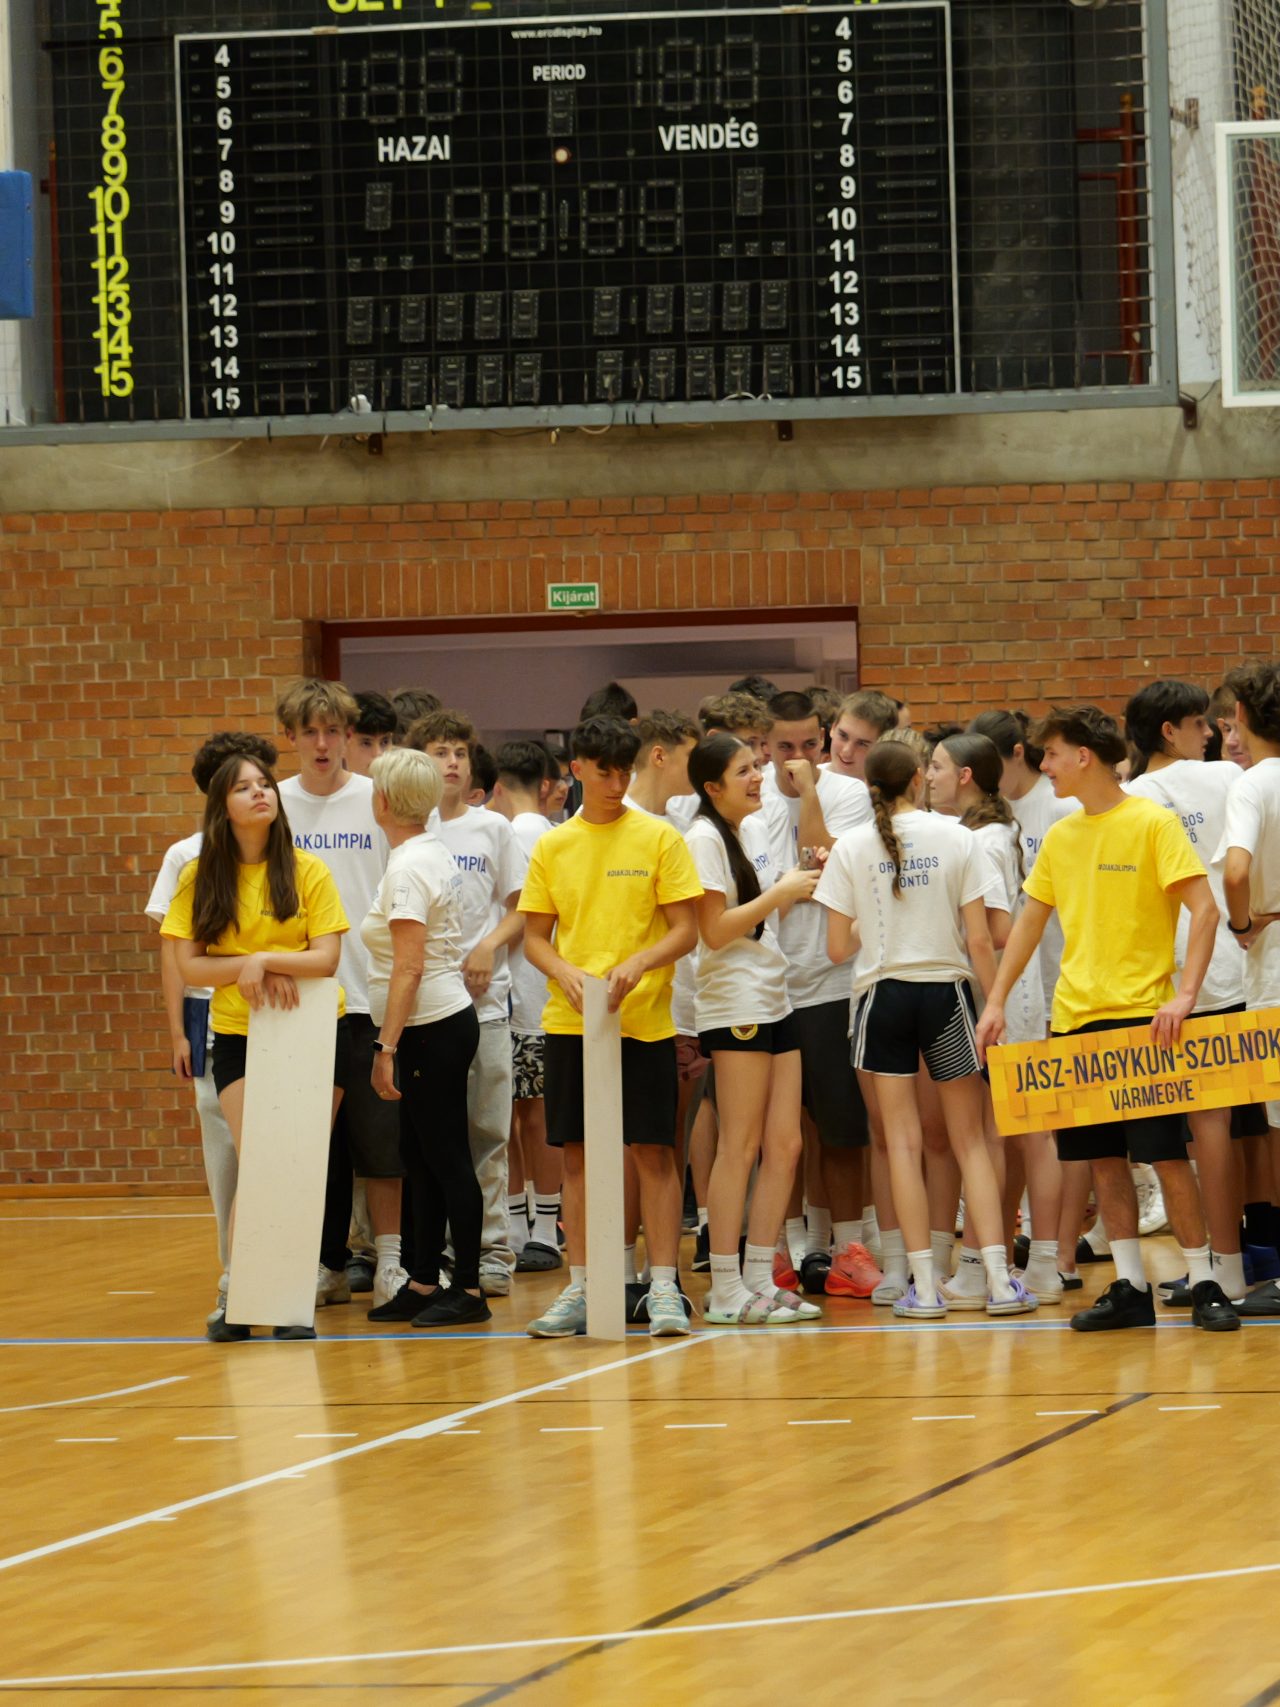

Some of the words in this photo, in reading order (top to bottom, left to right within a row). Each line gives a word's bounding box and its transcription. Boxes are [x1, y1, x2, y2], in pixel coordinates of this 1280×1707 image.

[98, 10, 123, 39] 5
[835, 16, 851, 40] 4
[98, 47, 125, 82] 6
[214, 44, 230, 67] 4
[837, 49, 853, 72] 5
[532, 64, 586, 82] PERIOD
[102, 80, 125, 116] 7
[216, 76, 232, 99] 5
[837, 80, 854, 104] 6
[217, 107, 233, 130] 6
[838, 112, 854, 135] 7
[101, 115, 127, 150] 8
[658, 116, 759, 151] VENDÉG
[217, 138, 233, 161] 7
[377, 134, 450, 162] HAZAI
[840, 144, 855, 167] 8
[102, 150, 128, 186] 9
[219, 169, 234, 193] 8
[840, 175, 856, 199] 9
[88, 186, 130, 222] 10
[219, 201, 235, 224] 9
[827, 207, 857, 231] 10
[90, 222, 123, 257] 11
[207, 231, 236, 254] 10
[829, 239, 855, 262] 11
[90, 256, 130, 291] 12
[209, 262, 234, 285] 11
[829, 270, 859, 294] 12
[92, 290, 132, 326] 13
[208, 293, 238, 317] 12
[830, 302, 860, 326] 13
[92, 326, 133, 361] 14
[210, 325, 238, 348] 13
[831, 333, 861, 357] 14
[94, 361, 134, 397] 15
[210, 356, 240, 379] 14
[832, 365, 862, 389] 15
[212, 387, 241, 410] 15
[552, 590, 595, 605] Kijárat
[878, 855, 939, 874] ORZÁGOS
[899, 870, 929, 888] ÖNTŐ
[1110, 1079, 1195, 1111] VÁRMEGYE
